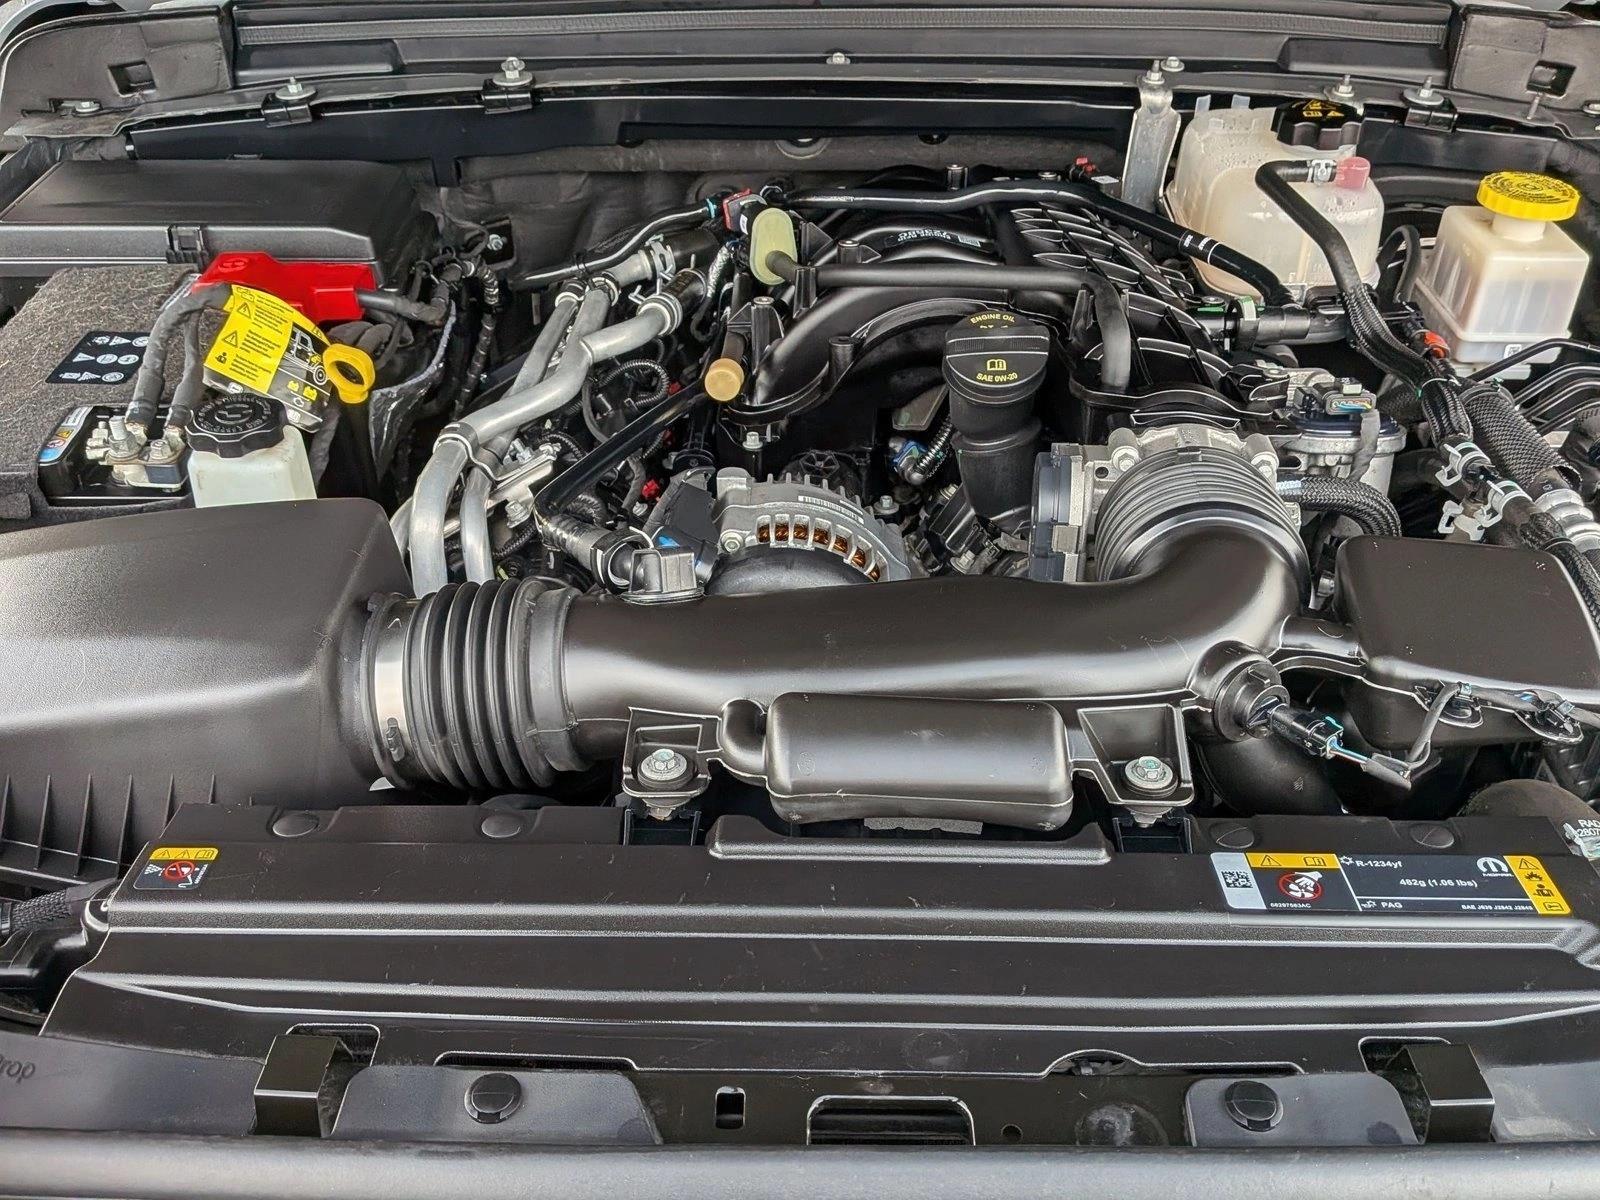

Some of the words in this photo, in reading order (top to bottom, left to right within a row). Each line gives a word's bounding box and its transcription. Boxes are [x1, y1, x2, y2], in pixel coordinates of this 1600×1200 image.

[970, 313, 1001, 324] ENGINE
[1002, 314, 1015, 323] OIL
[976, 372, 993, 383] SAE
[994, 372, 1018, 383] 0W-20
[1355, 860, 1402, 869] R-1234yf
[1400, 878, 1427, 887] 482g
[1428, 878, 1455, 888] (1.06
[1456, 879, 1478, 888] lbs)
[1381, 901, 1403, 909] PAG
